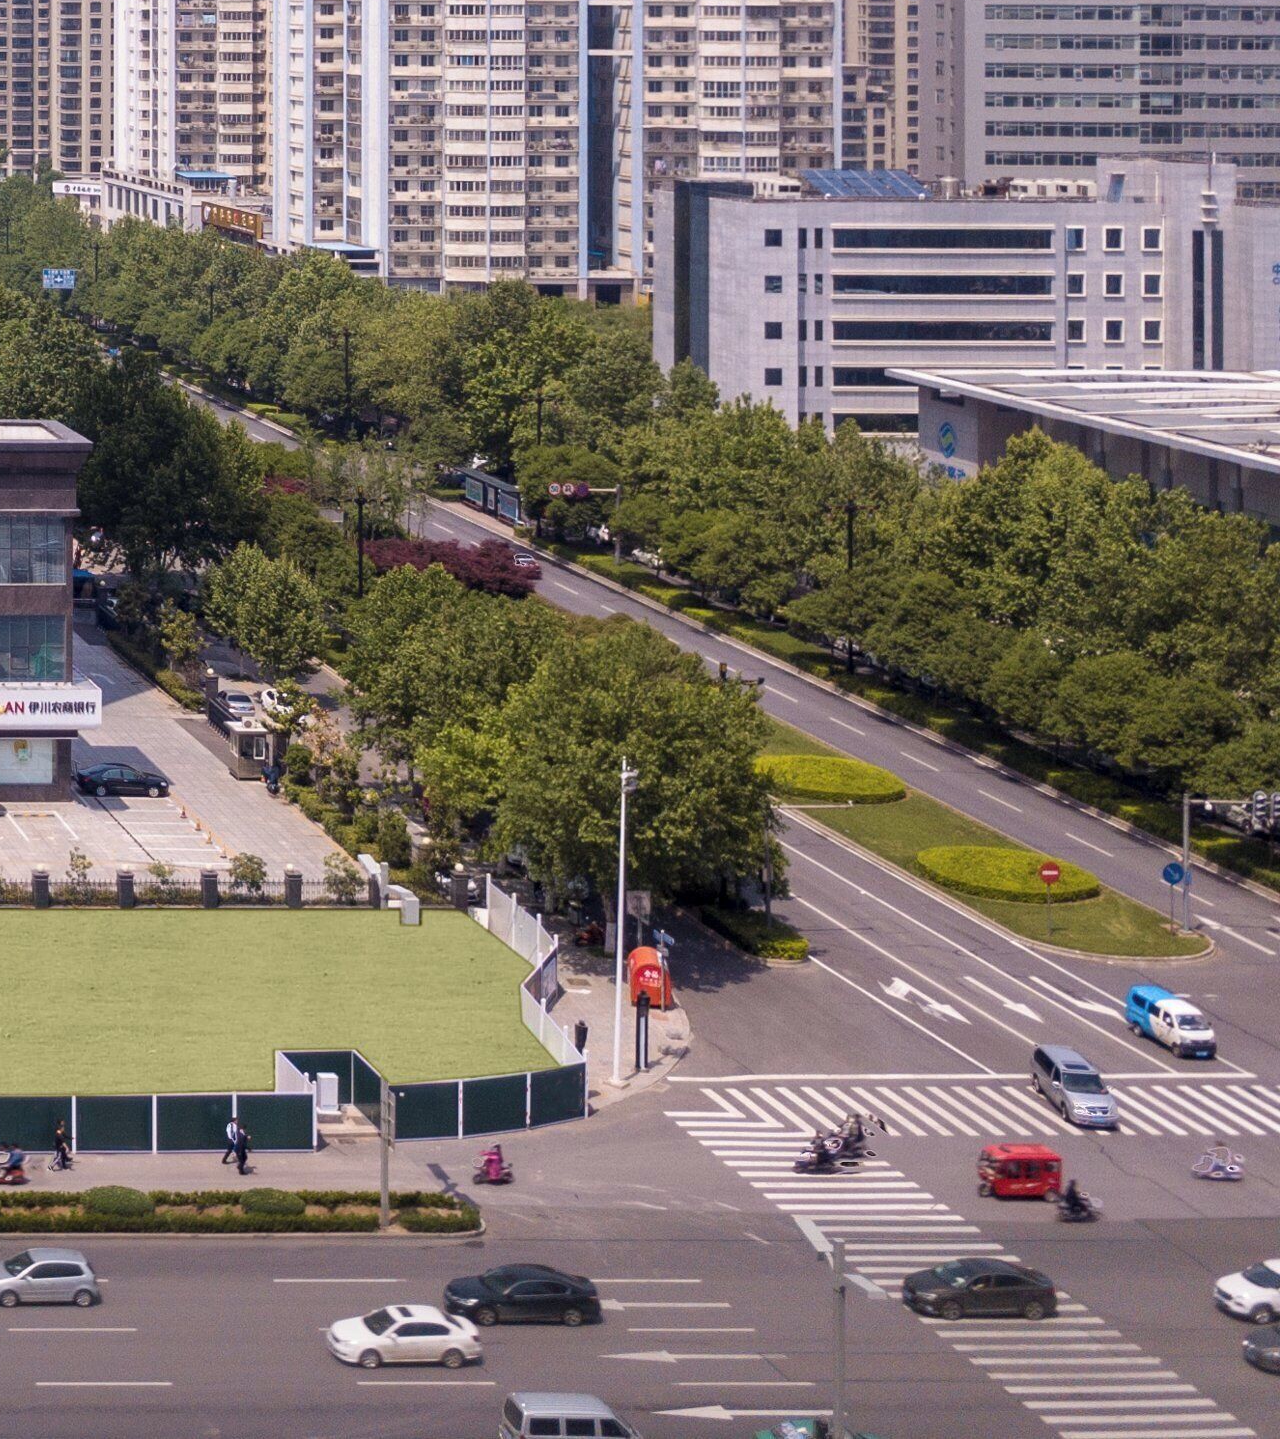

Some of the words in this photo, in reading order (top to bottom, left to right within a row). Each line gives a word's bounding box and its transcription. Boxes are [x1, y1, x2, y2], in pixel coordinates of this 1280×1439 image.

[28, 701, 96, 715] 伊川农商银行
